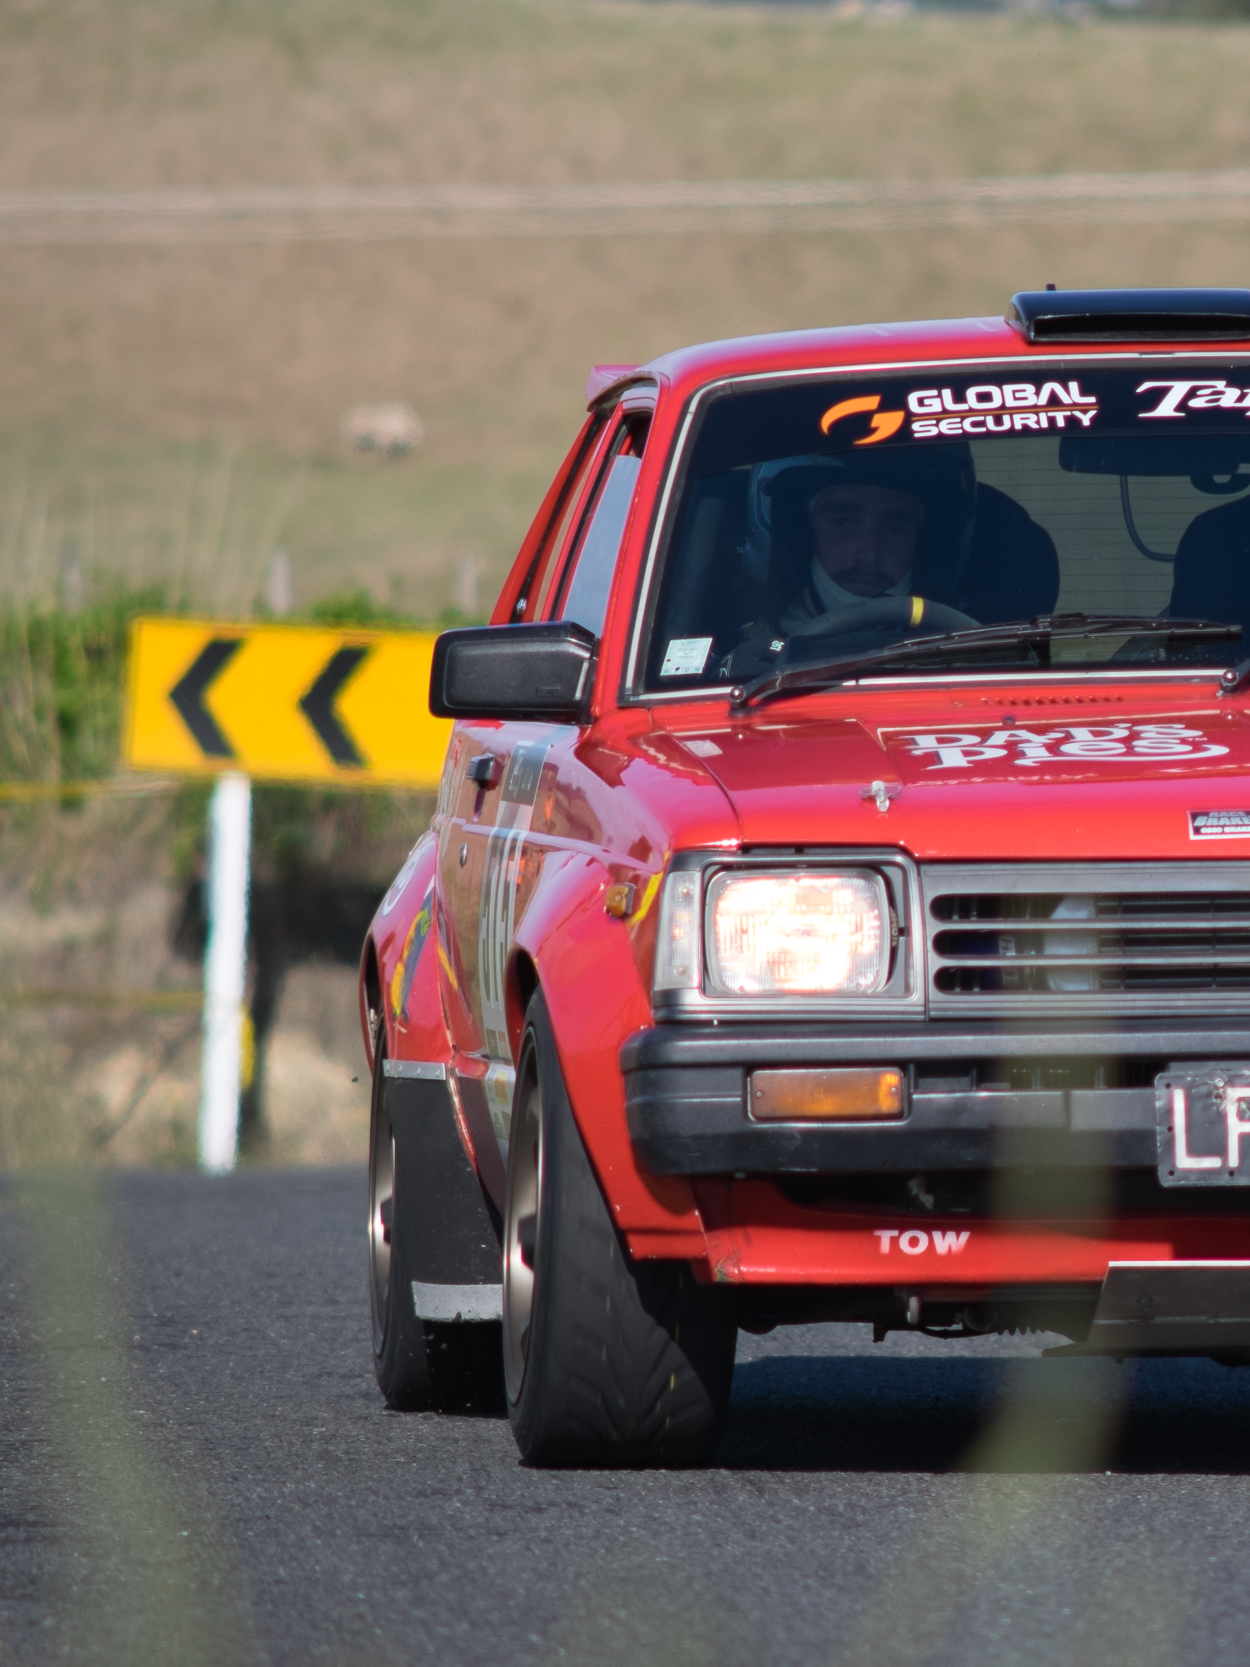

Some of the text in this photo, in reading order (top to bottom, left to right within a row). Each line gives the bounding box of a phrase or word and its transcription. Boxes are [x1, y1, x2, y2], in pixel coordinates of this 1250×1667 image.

[908, 381, 1096, 413] GLOBAL
[911, 409, 1099, 438] SECURITY
[897, 723, 1204, 748] DAD'S
[873, 1229, 971, 1256] TOW
